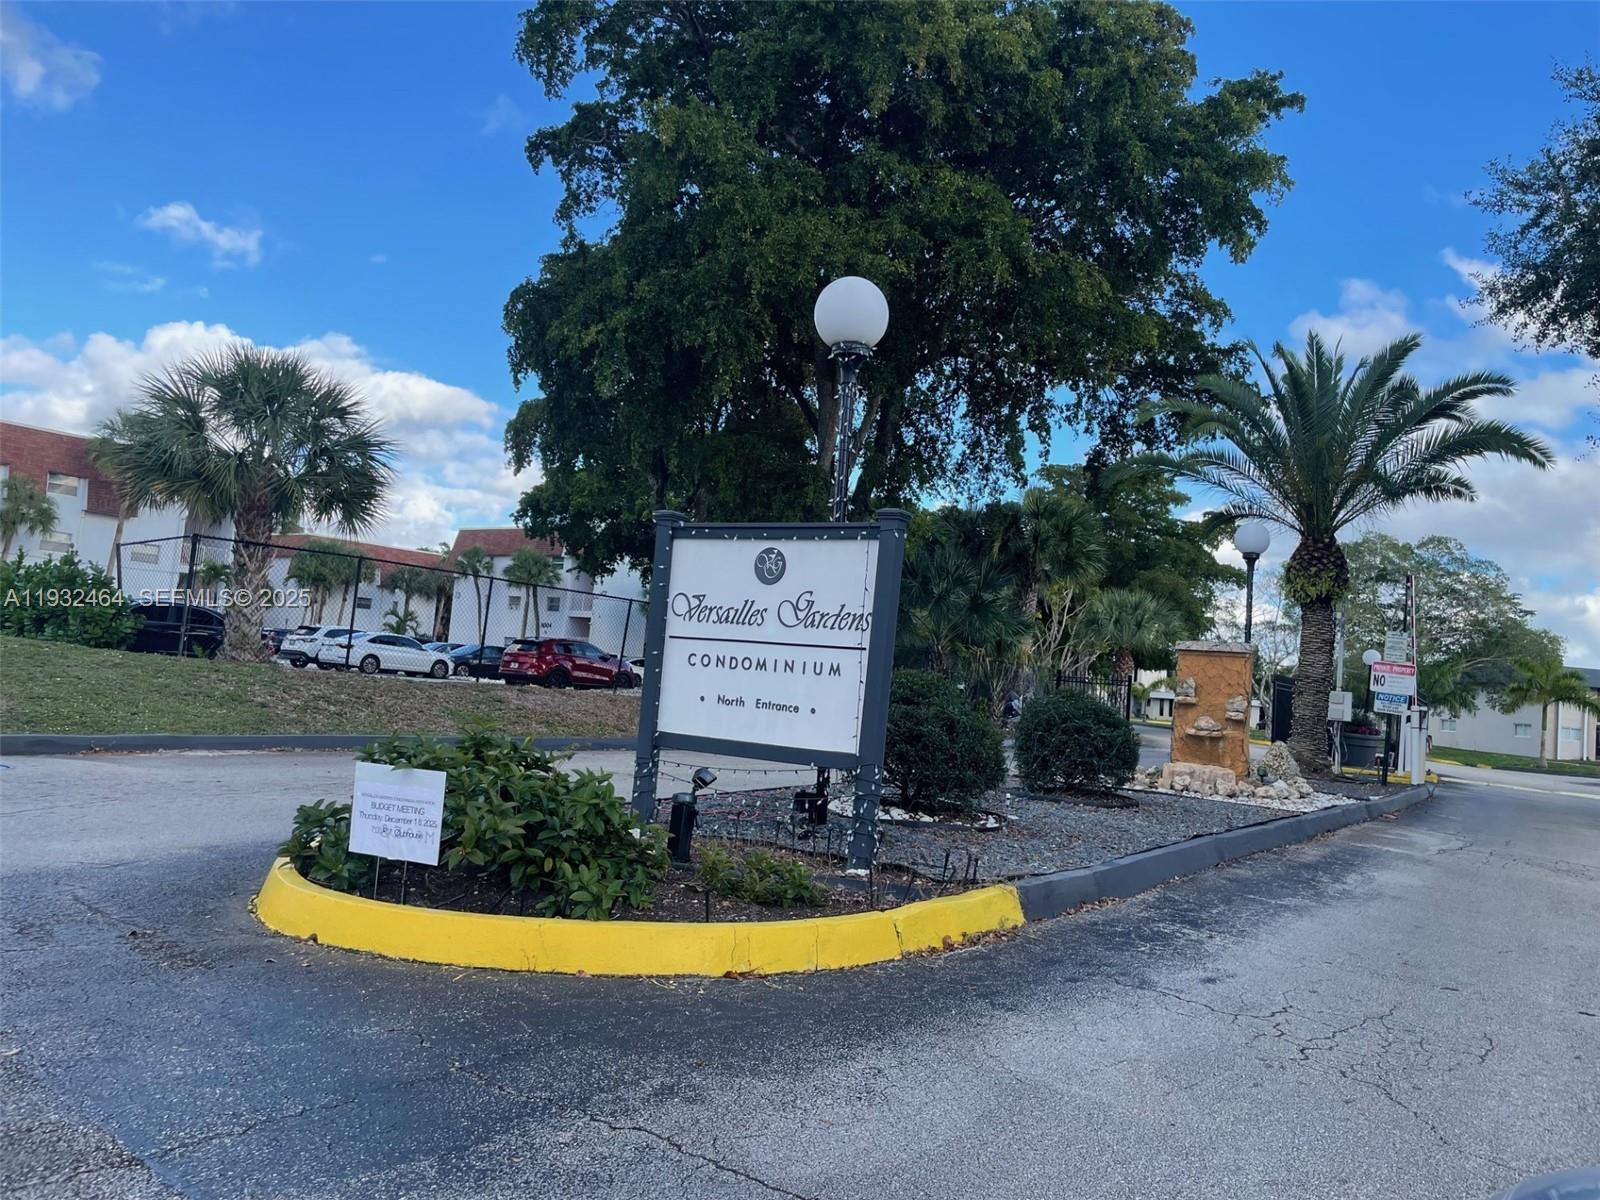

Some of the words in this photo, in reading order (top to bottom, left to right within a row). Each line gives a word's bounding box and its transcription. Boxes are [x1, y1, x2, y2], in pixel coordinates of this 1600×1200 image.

[671, 592, 768, 626] Versailles
[777, 590, 873, 632] Gardens
[687, 652, 842, 677] CONDOMINIUM
[1373, 673, 1386, 687] NO
[717, 694, 745, 708] North
[755, 699, 800, 714] Entrance
[1377, 693, 1406, 703] NOTICE
[370, 801, 396, 812] BUDGET
[396, 805, 425, 816] MEETING
